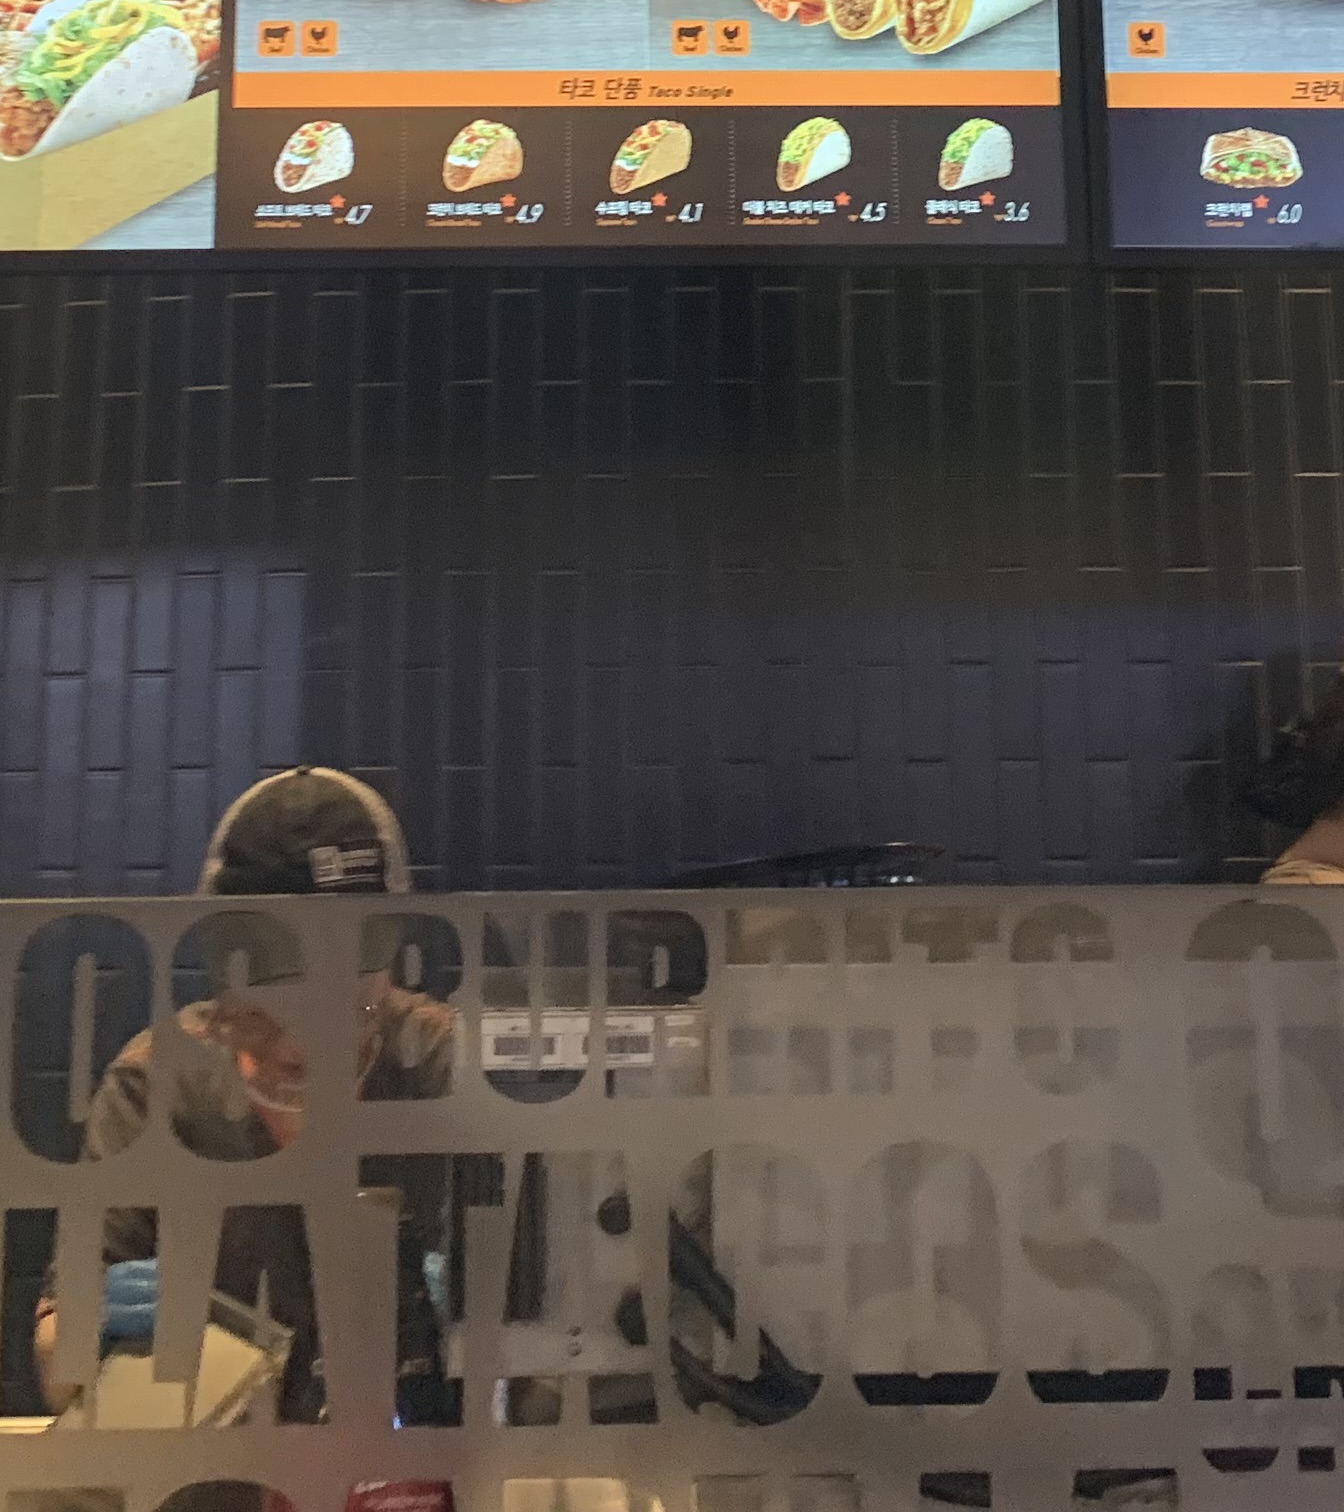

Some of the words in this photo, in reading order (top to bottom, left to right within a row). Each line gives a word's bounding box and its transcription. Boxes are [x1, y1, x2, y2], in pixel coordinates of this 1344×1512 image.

[558, 78, 596, 100] 타코
[603, 78, 642, 100] 단품
[647, 85, 682, 98] Taco
[685, 85, 734, 99] Single
